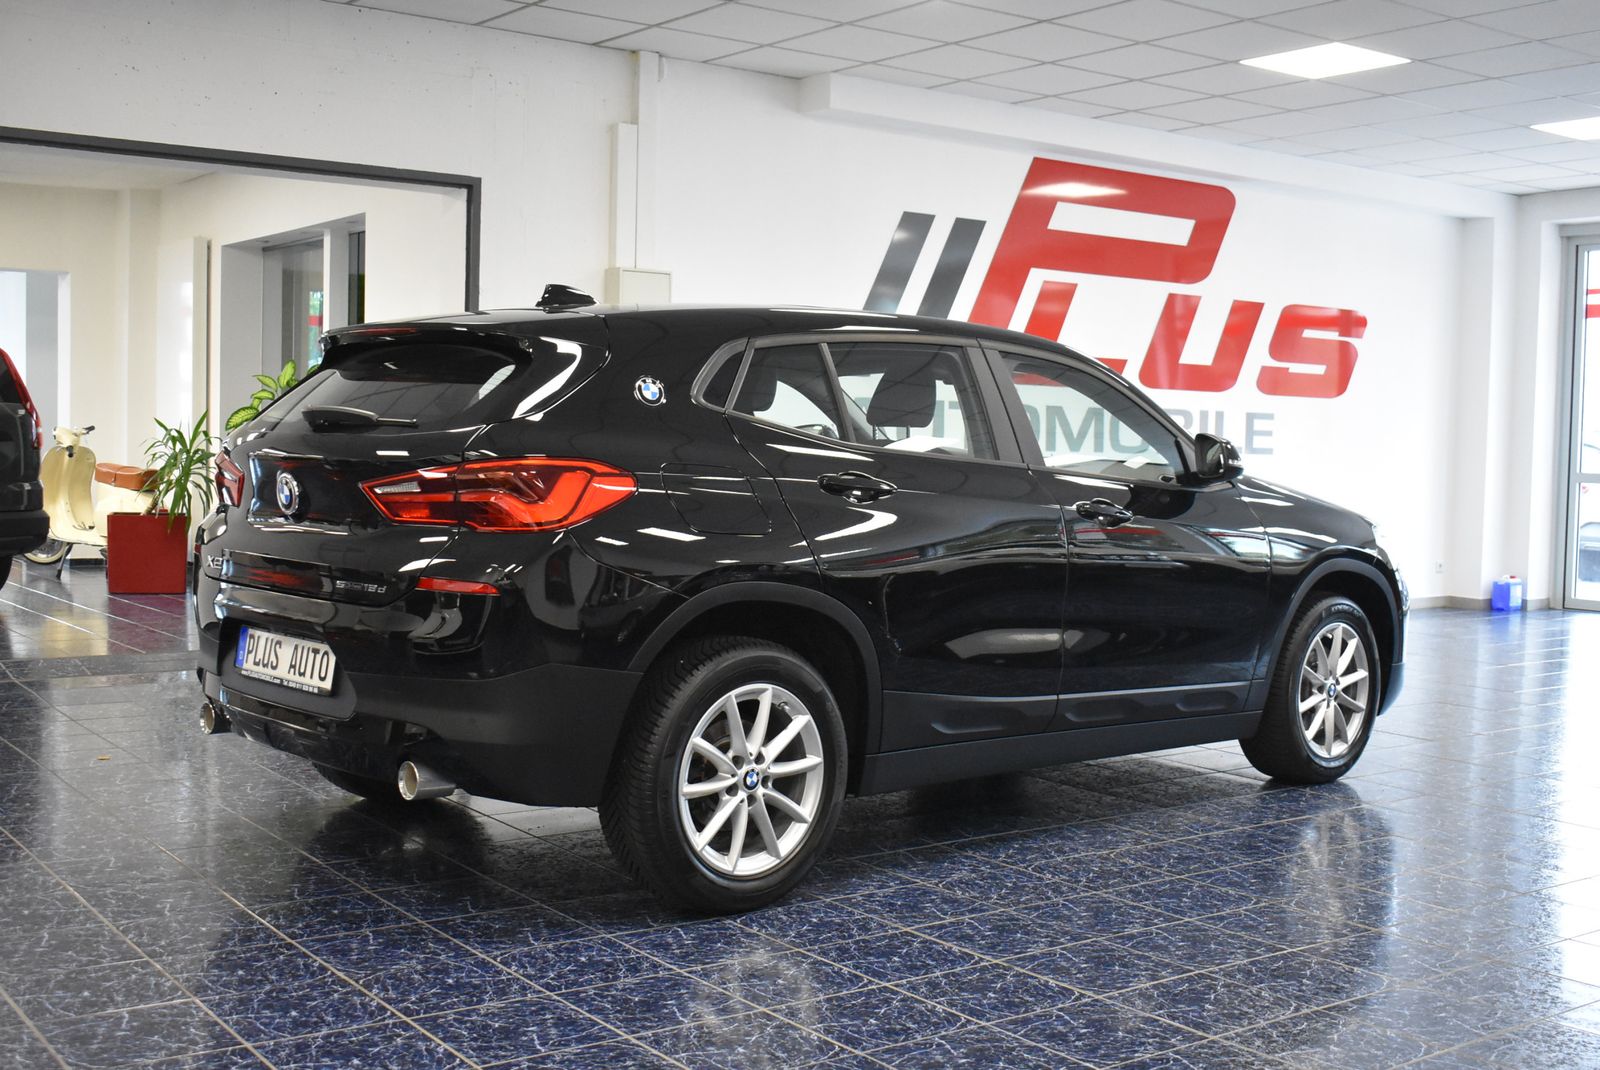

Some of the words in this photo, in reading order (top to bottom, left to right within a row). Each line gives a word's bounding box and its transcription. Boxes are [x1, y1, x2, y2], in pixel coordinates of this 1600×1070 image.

[854, 397, 1275, 456] MOILE
[206, 555, 223, 569] X2
[245, 632, 282, 671] PLUS
[288, 643, 330, 682] AUTO
